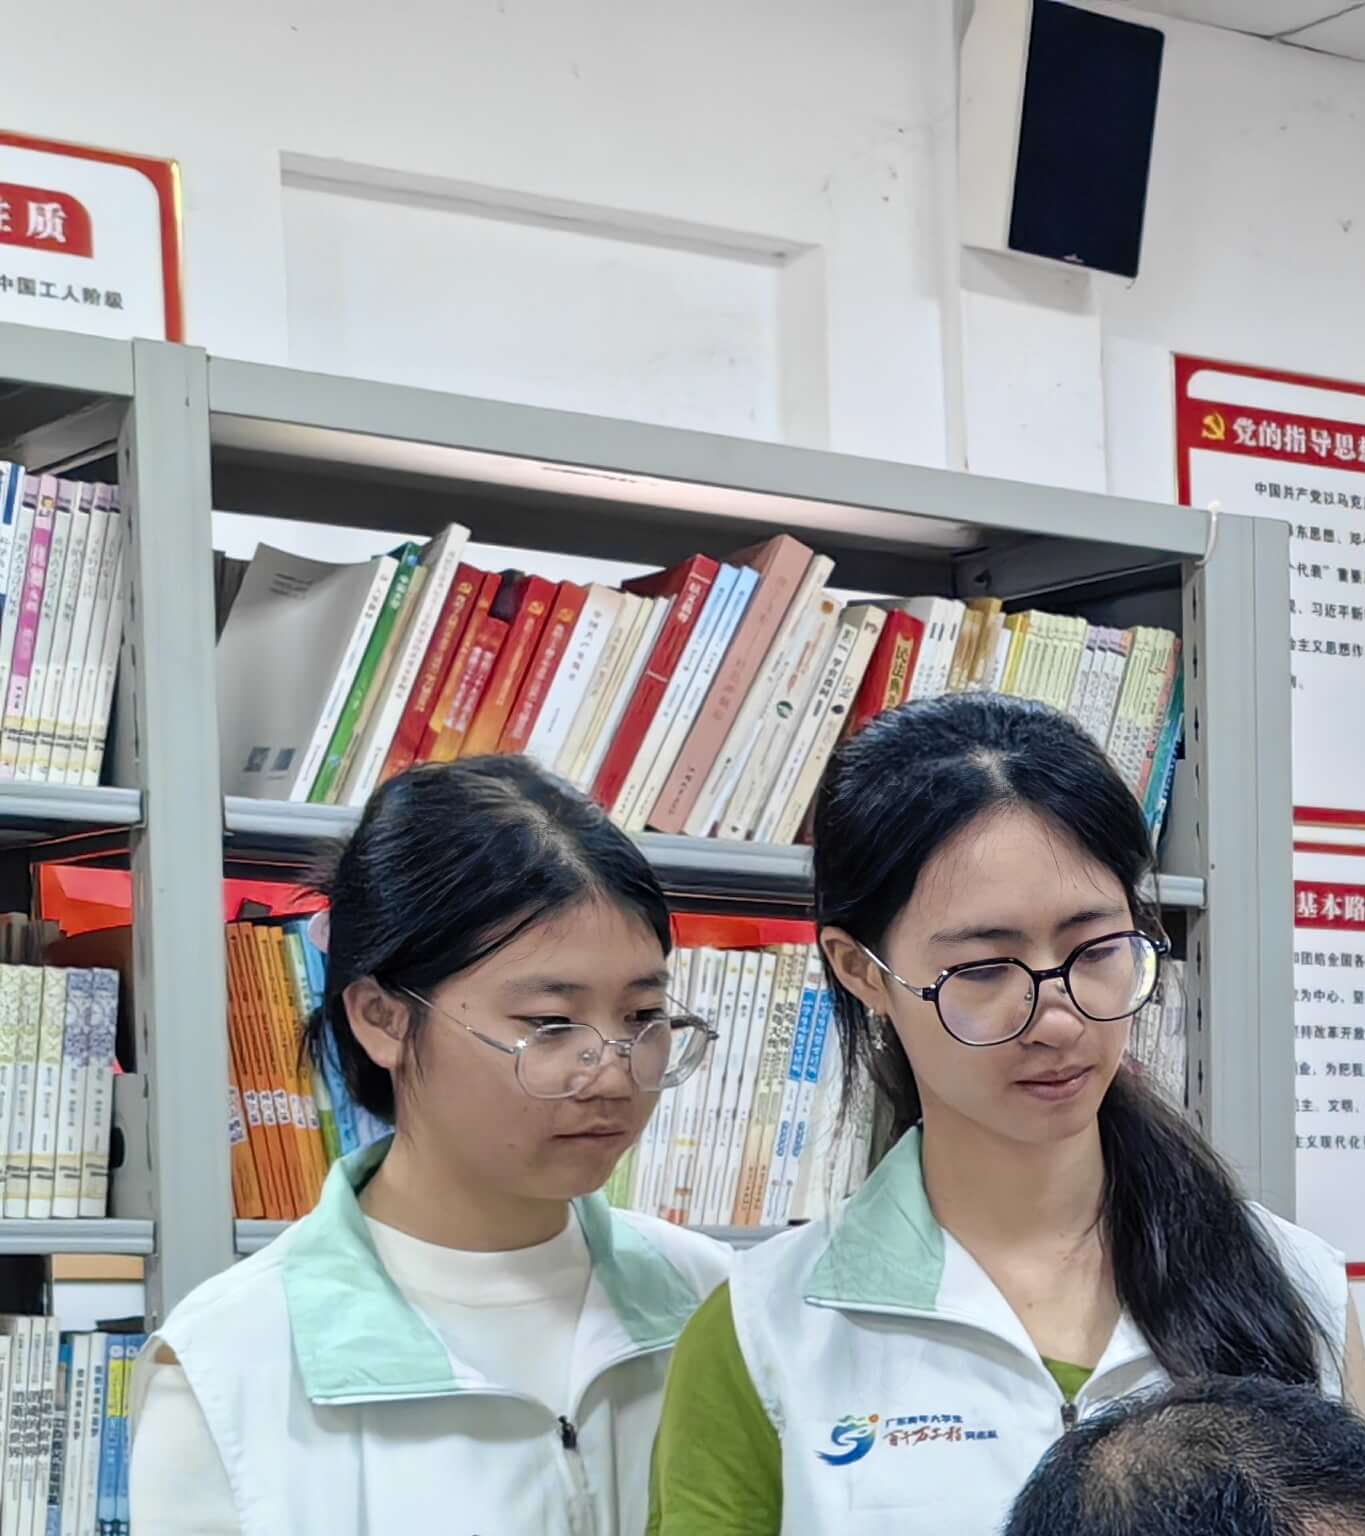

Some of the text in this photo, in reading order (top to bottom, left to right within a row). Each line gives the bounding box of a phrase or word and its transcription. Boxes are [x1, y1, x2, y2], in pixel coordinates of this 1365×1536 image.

[0, 274, 125, 310] 中国工人阶级
